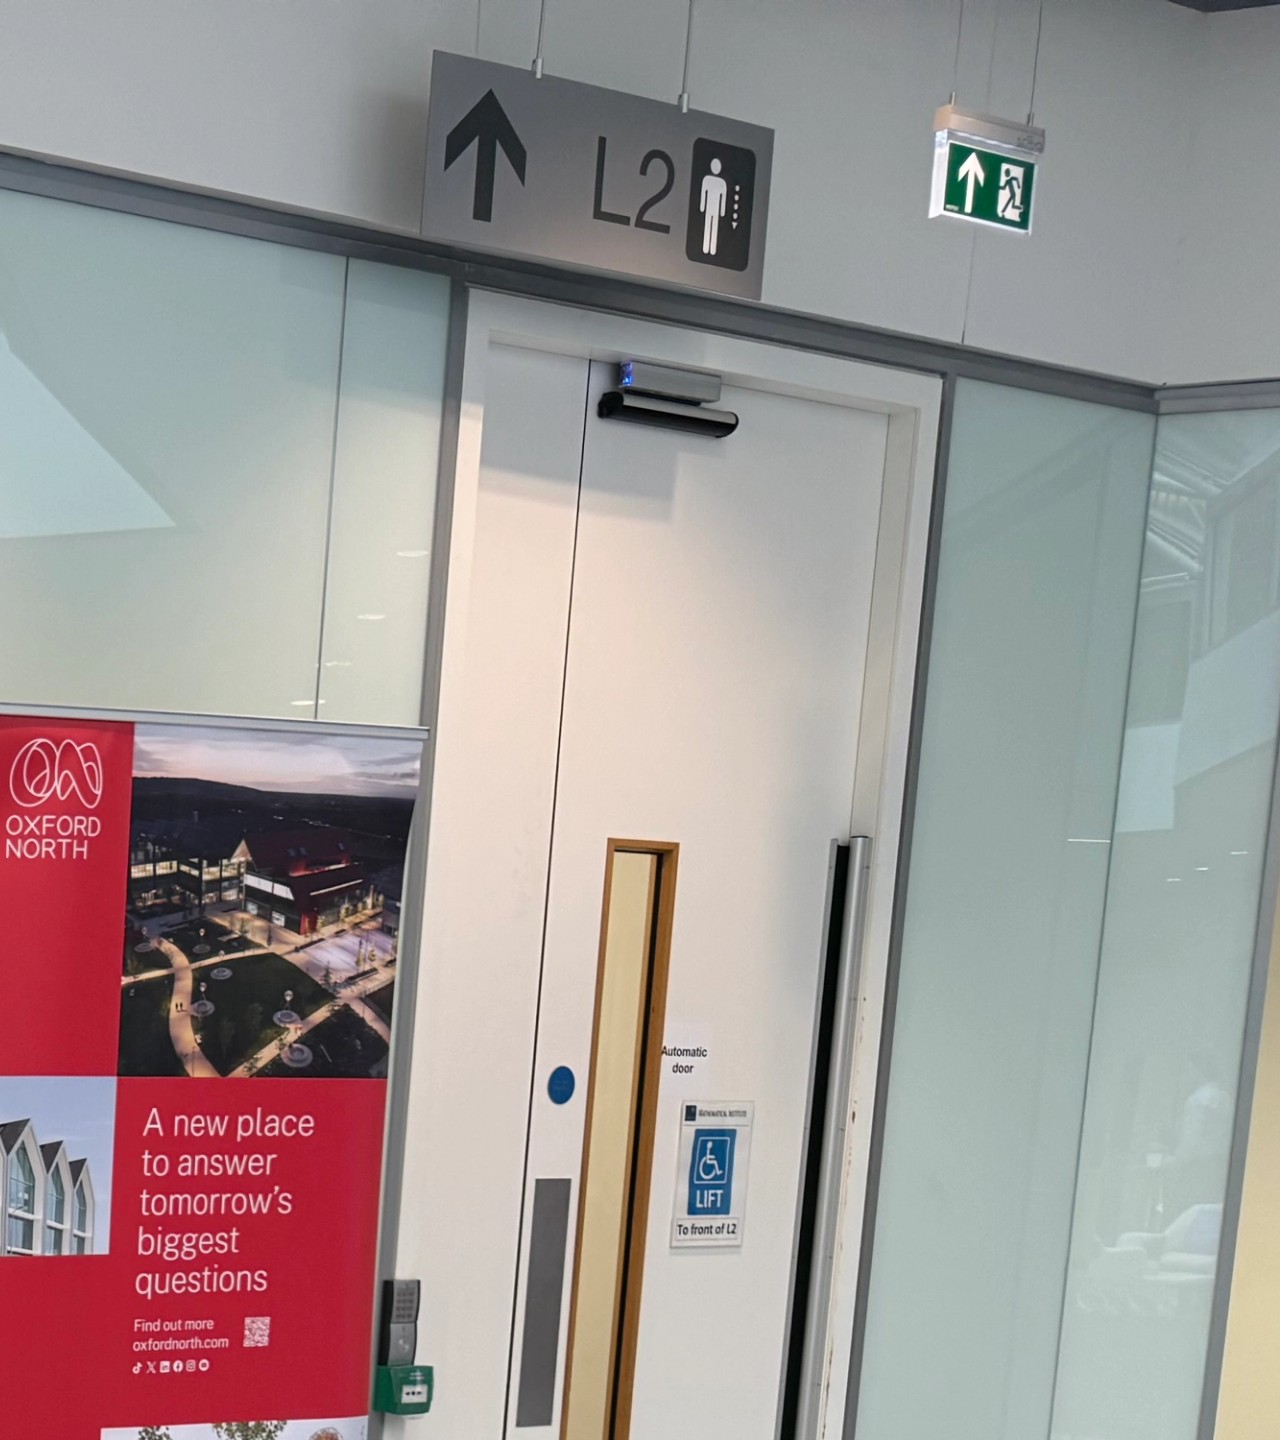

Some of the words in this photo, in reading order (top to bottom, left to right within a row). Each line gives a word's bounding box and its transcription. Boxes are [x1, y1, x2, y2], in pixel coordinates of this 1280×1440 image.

[592, 135, 675, 235] L2
[5, 814, 101, 837] OXFORD
[5, 838, 88, 860] NORTH
[661, 1046, 708, 1058] Automatic
[671, 1063, 694, 1074] door
[142, 1107, 164, 1136] A
[174, 1114, 229, 1137] new
[236, 1106, 315, 1142] place
[141, 1149, 170, 1176] to
[177, 1153, 278, 1176] answer
[139, 1185, 293, 1216] tomorrow’s
[695, 1189, 724, 1209] LIFT
[677, 1223, 689, 1236] To
[690, 1223, 714, 1236] front
[715, 1222, 726, 1234] of
[726, 1223, 737, 1235] L2
[137, 1225, 240, 1261] biggest
[135, 1264, 268, 1300] questions
[134, 1318, 161, 1333] Find
[163, 1320, 182, 1331] out
[185, 1319, 214, 1330] more
[132, 1336, 229, 1352] oxfordnorth.com
